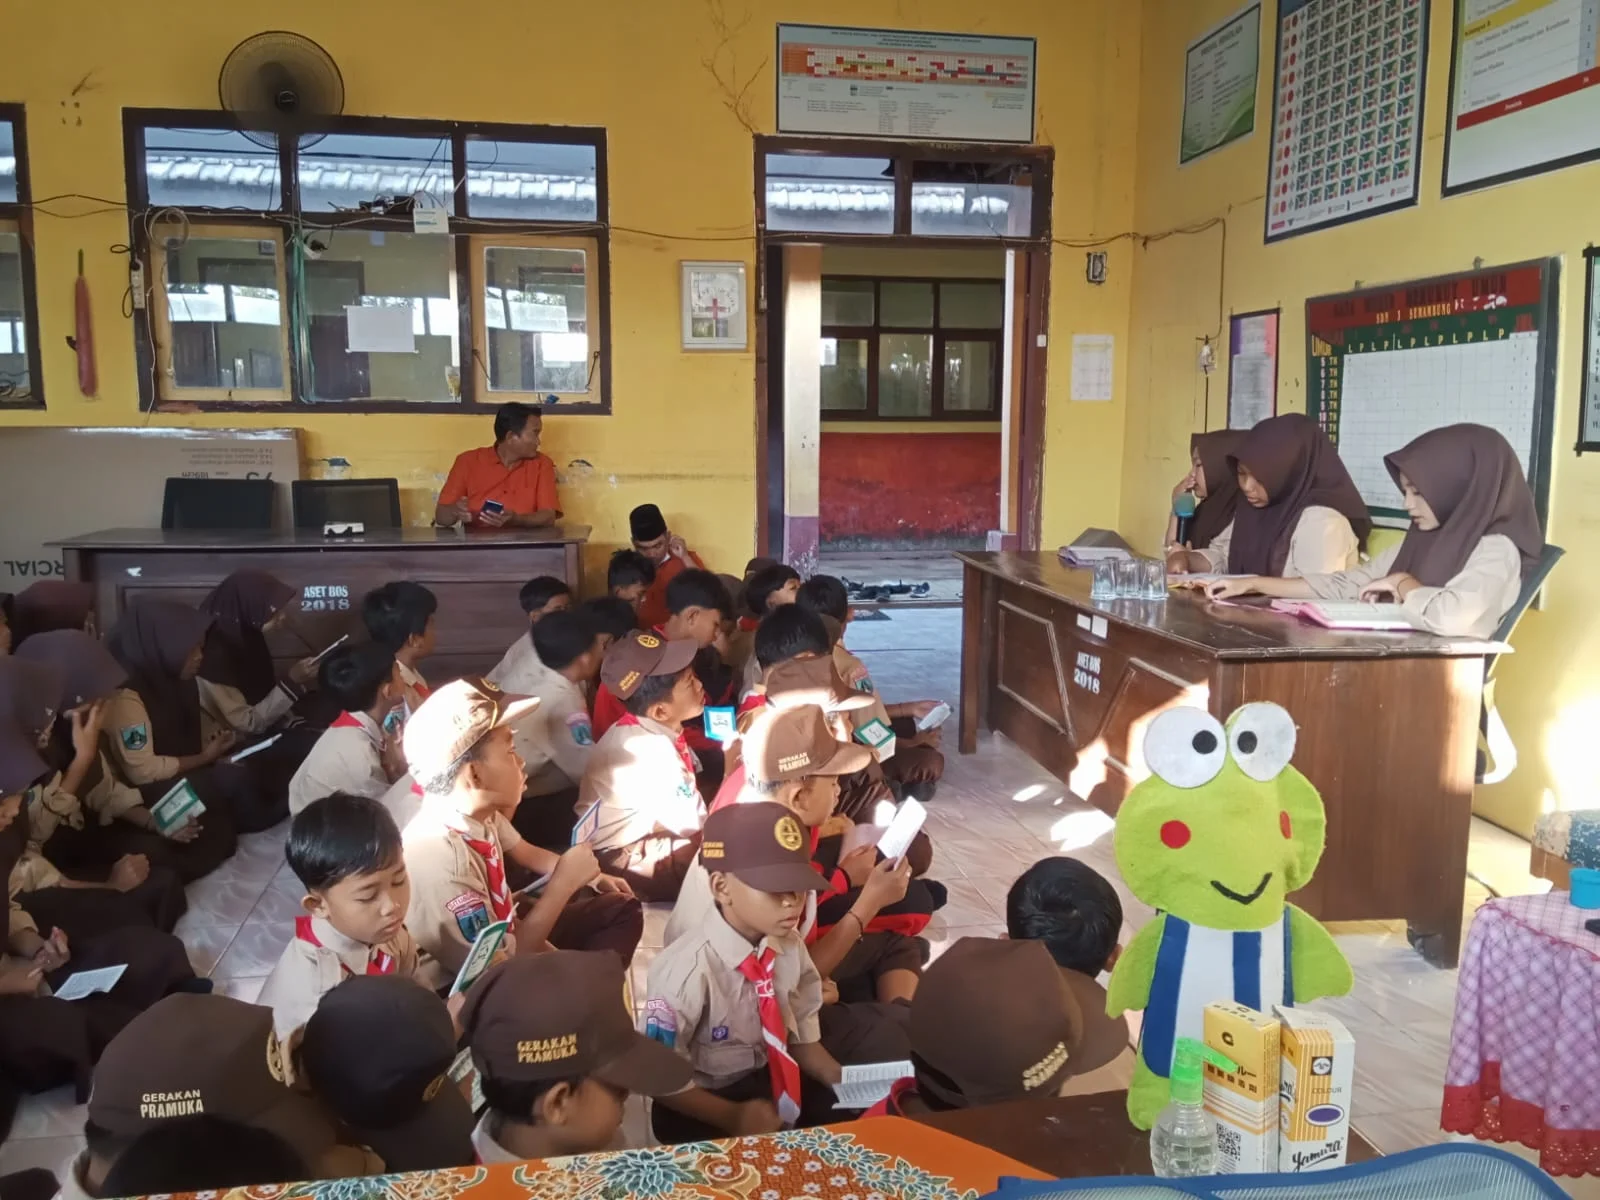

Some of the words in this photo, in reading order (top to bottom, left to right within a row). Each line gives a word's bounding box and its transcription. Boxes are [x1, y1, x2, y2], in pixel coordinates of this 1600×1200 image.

[303, 586, 326, 598] ASET
[328, 585, 349, 598] BOS
[301, 599, 350, 612] 2018
[1073, 668, 1101, 695] 2018
[517, 1033, 577, 1052] GERAKAN
[518, 1044, 577, 1064] PRAMUKA
[142, 1089, 201, 1103] GERAKAN
[140, 1099, 204, 1119] PRAMUKA
